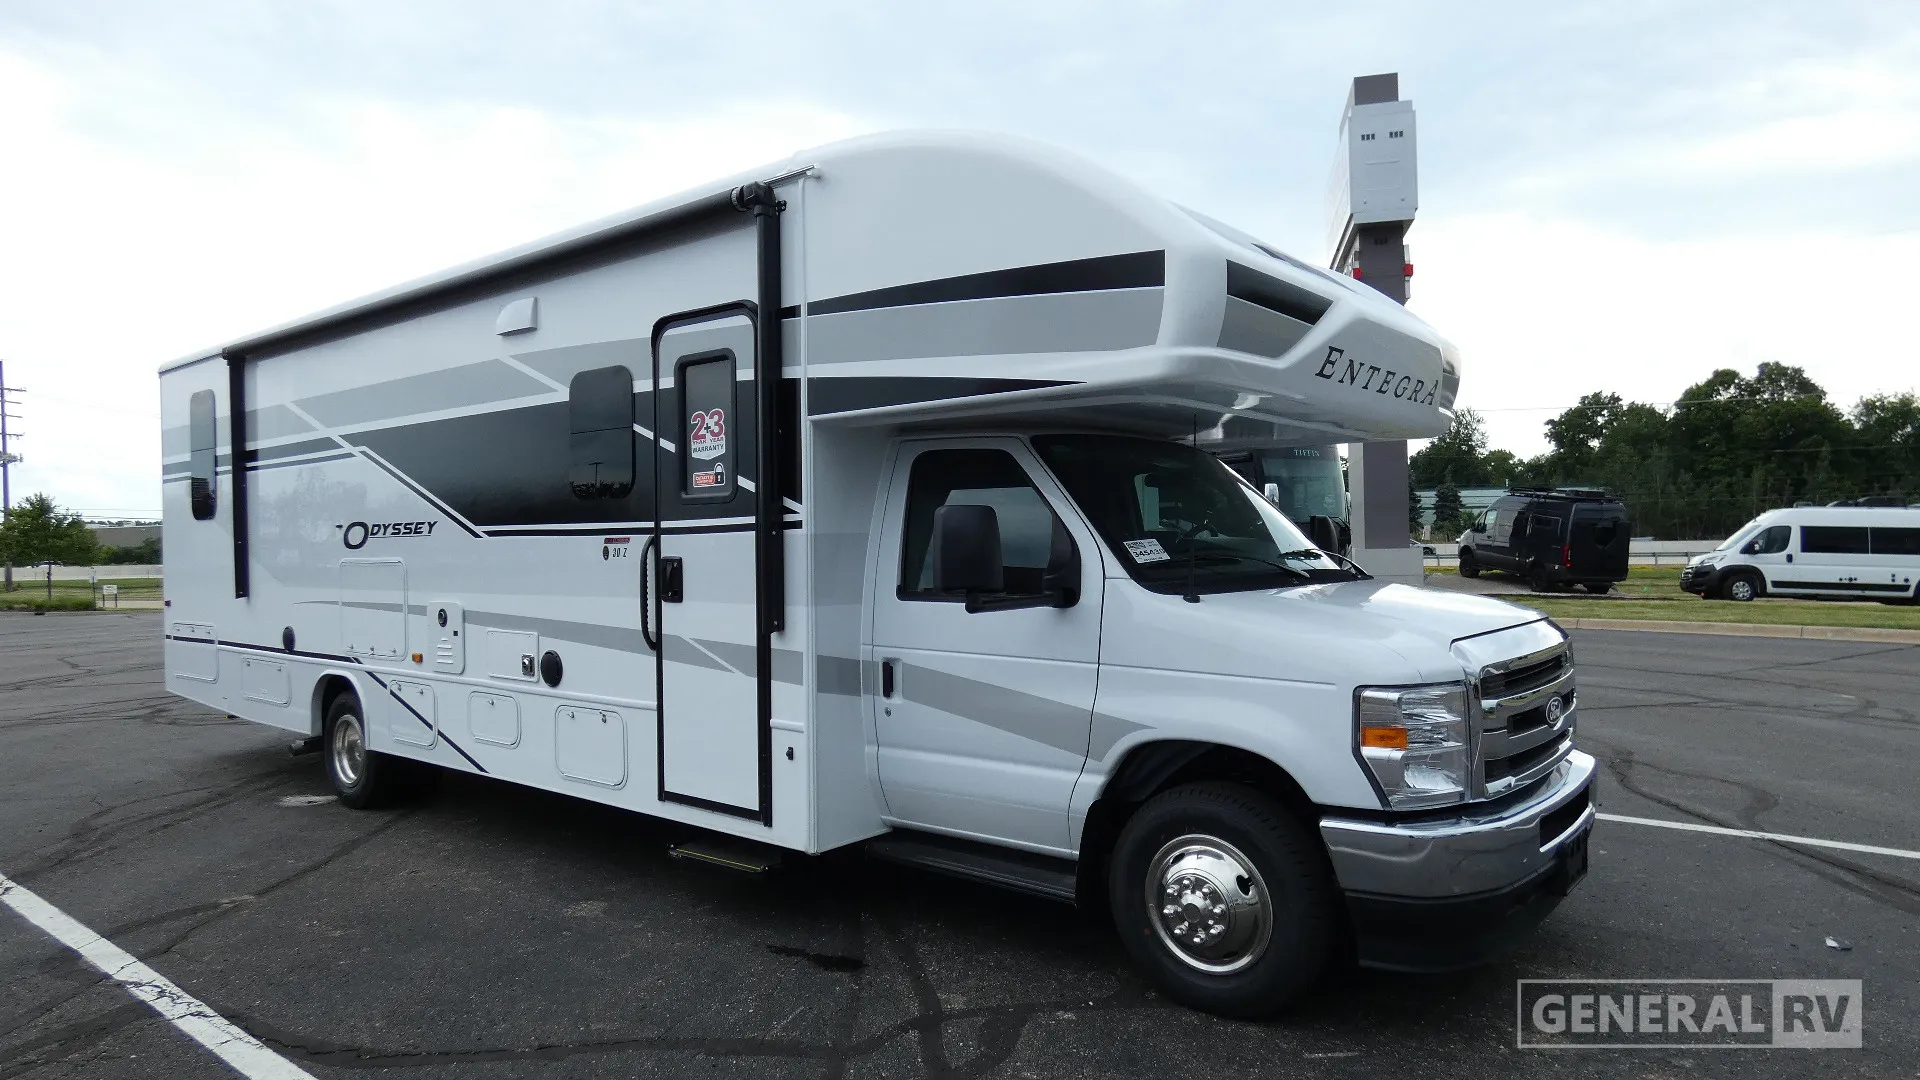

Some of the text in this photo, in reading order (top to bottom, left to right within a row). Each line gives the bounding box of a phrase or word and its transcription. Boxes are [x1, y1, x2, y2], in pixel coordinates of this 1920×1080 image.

[1315, 345, 1439, 406] ENTEGRA
[693, 444, 724, 454] WARRANTY
[1294, 449, 1320, 457] TIFFIN
[343, 520, 438, 550] ODYSSEY
